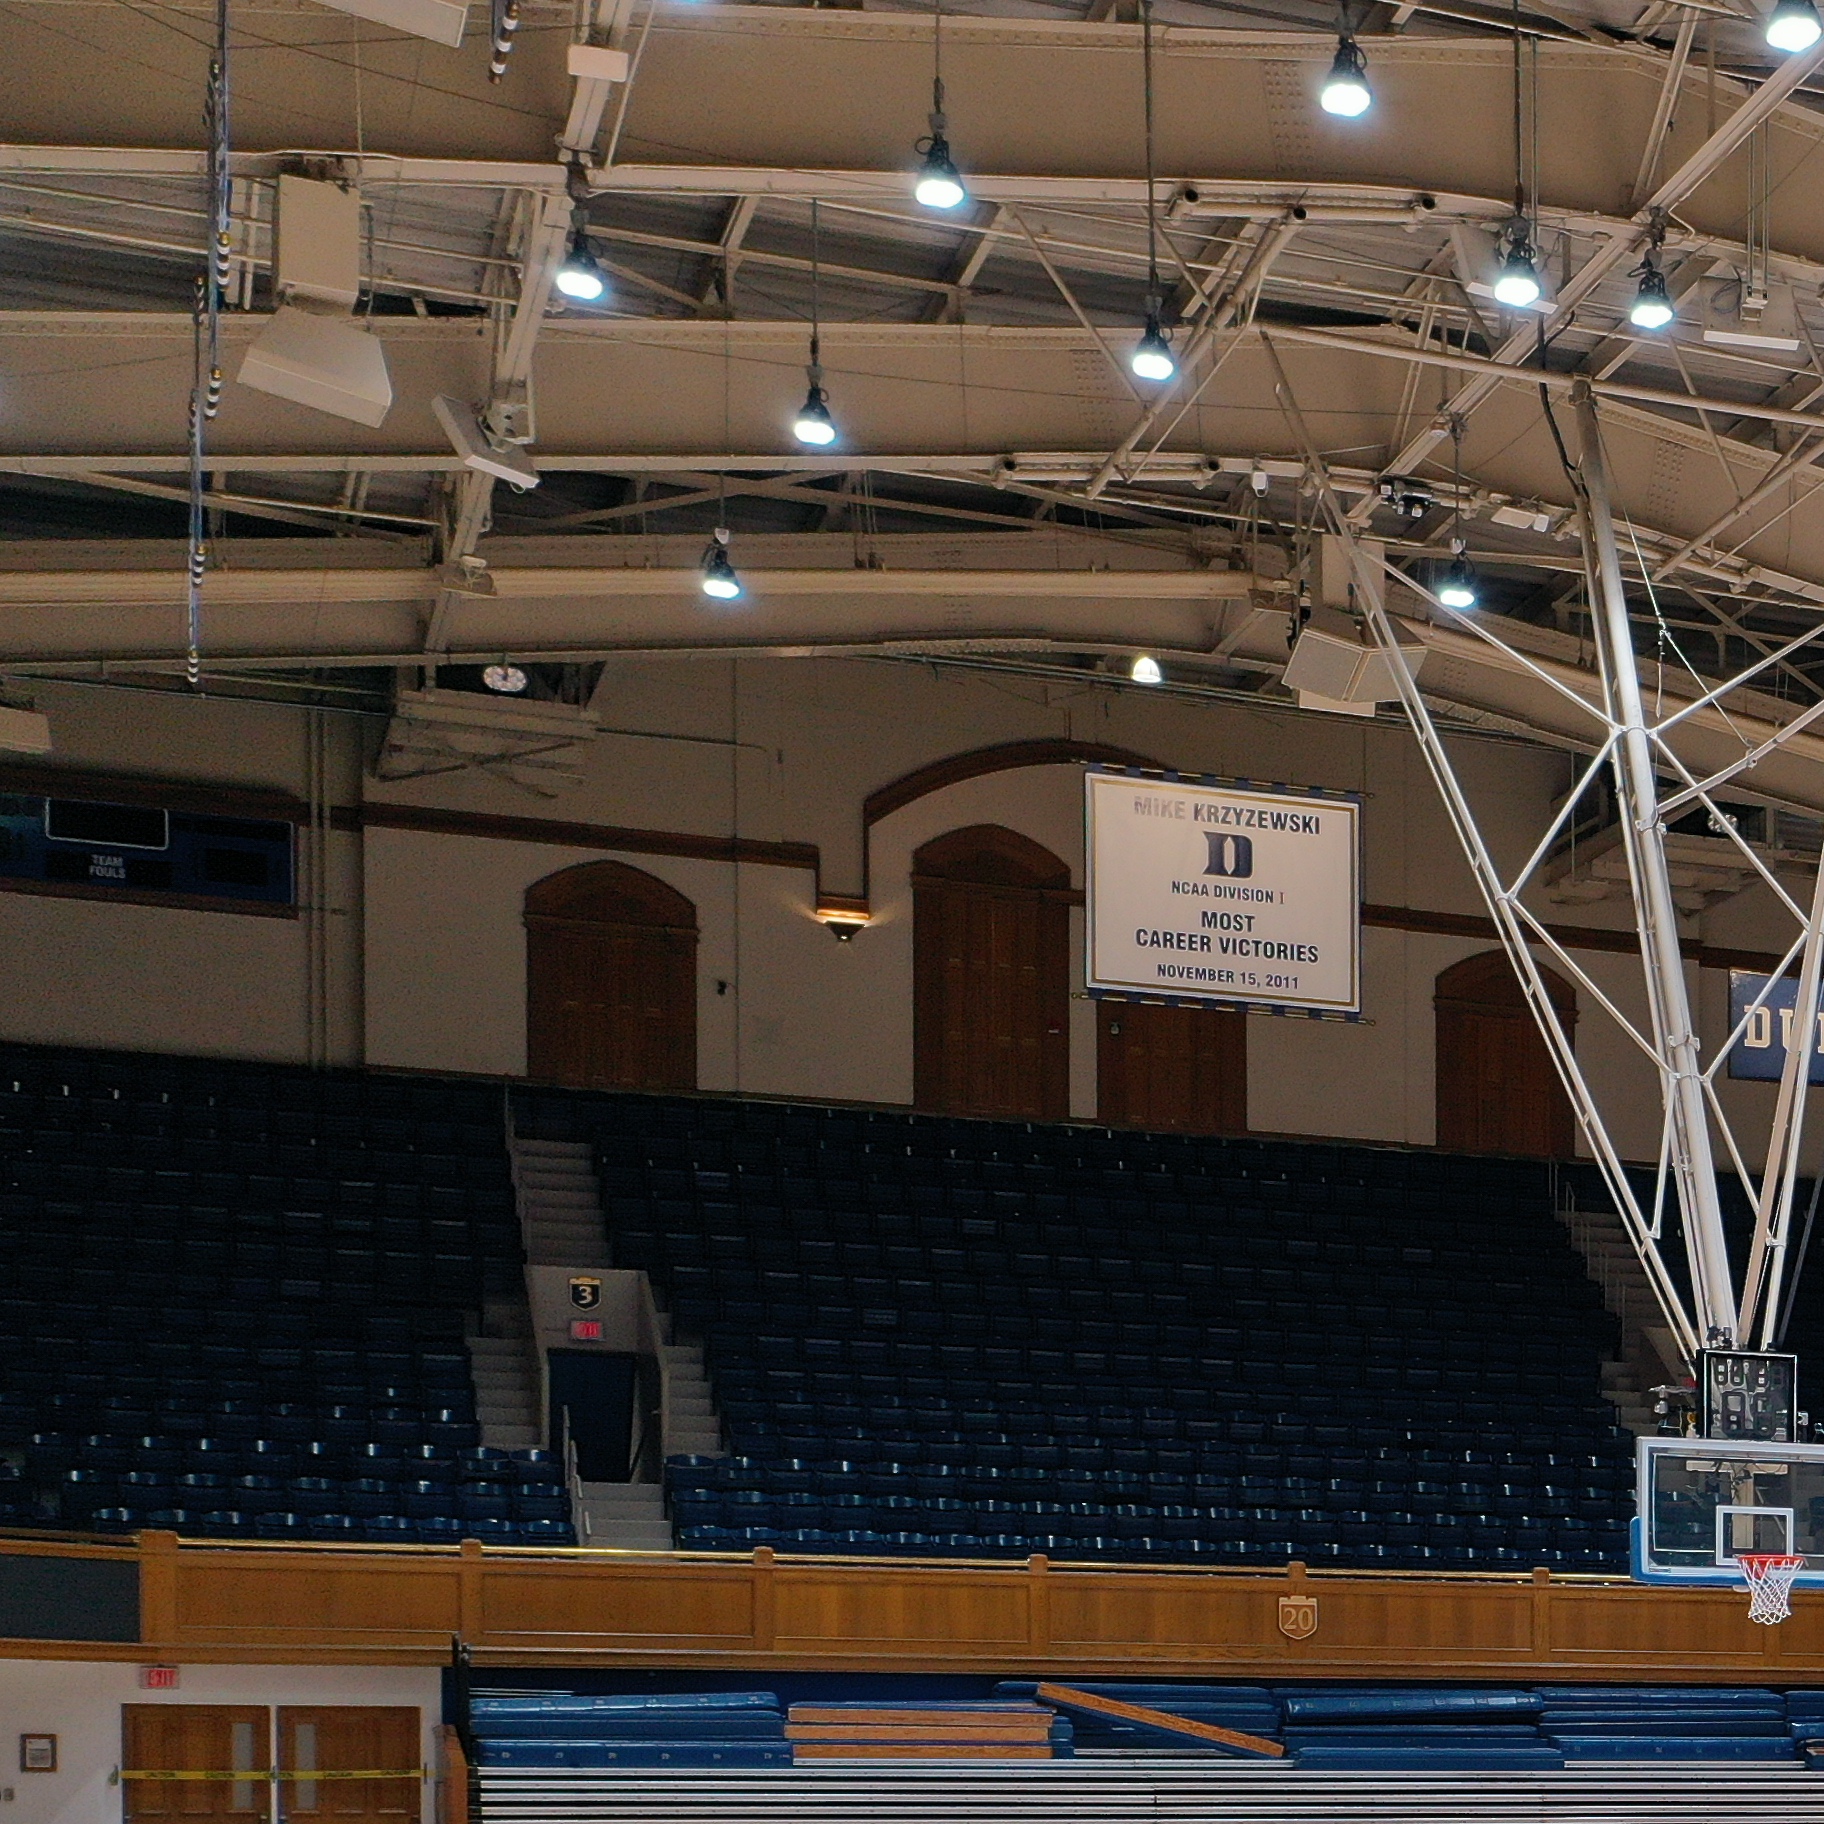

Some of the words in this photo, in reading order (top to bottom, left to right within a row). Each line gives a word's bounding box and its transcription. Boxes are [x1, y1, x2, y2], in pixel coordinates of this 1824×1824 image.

[1134, 796, 1186, 820] MIKE
[1193, 802, 1321, 835] KRZYZEWSKI
[90, 865, 126, 879] FOULS
[92, 854, 123, 867] TEAM
[1171, 880, 1209, 898] NCAA
[1213, 885, 1275, 904] DIVISION
[1279, 891, 1285, 904] I
[1201, 910, 1256, 933] MOST
[1135, 928, 1212, 953] CAREER
[1218, 936, 1320, 964] VICTORIES
[1157, 964, 1234, 983] NOVEMBER
[1240, 972, 1261, 988] 15,
[1265, 973, 1299, 990] 2011
[579, 1286, 592, 1303] 3
